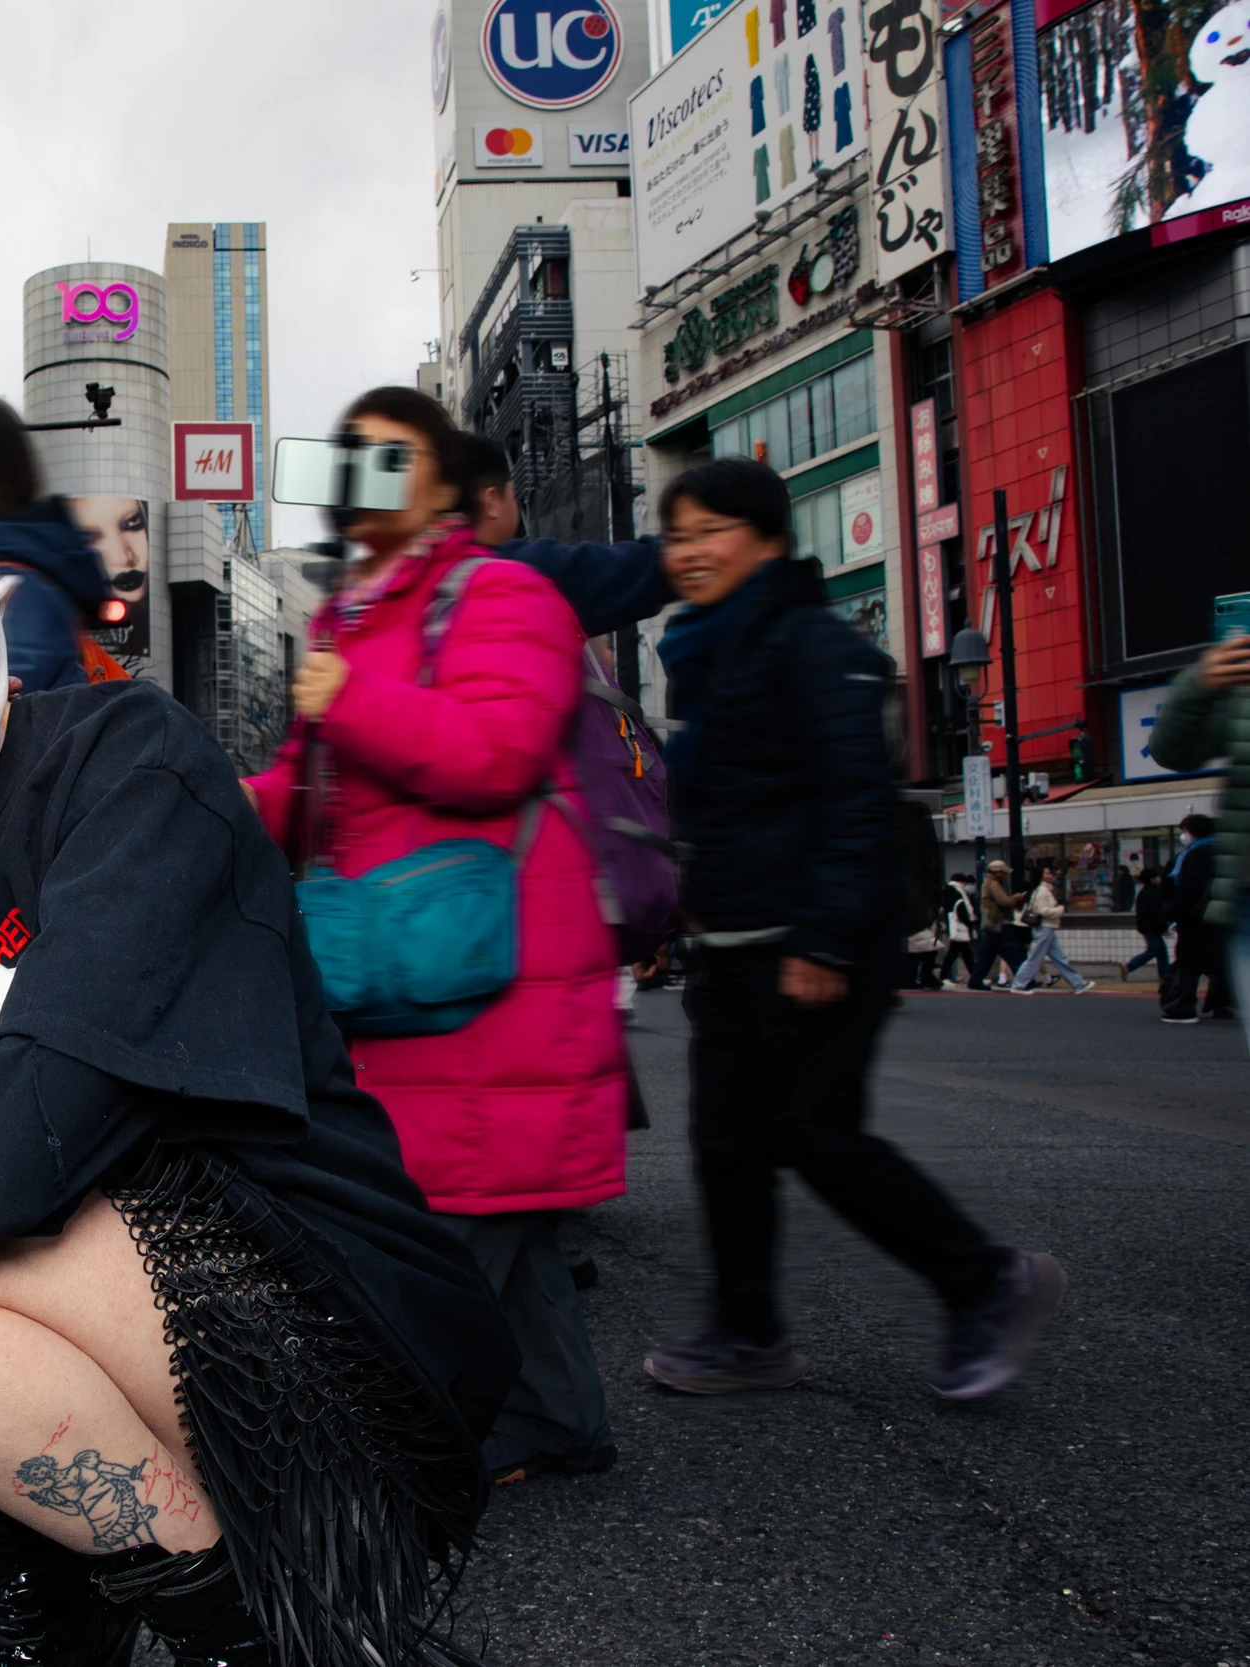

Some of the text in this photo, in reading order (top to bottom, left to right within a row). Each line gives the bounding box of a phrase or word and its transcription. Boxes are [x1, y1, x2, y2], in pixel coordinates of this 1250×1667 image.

[648, 67, 724, 148] Viscotecs
[672, 119, 695, 148] your
[699, 86, 734, 125] brand
[869, 0, 944, 252] もんじゃ
[574, 134, 629, 153] VISA
[971, 14, 1013, 274] 三千里薬品
[1222, 205, 1250, 222] Rak
[172, 240, 208, 248] INDIGO
[56, 282, 139, 341] 109
[194, 448, 233, 475] H&M
